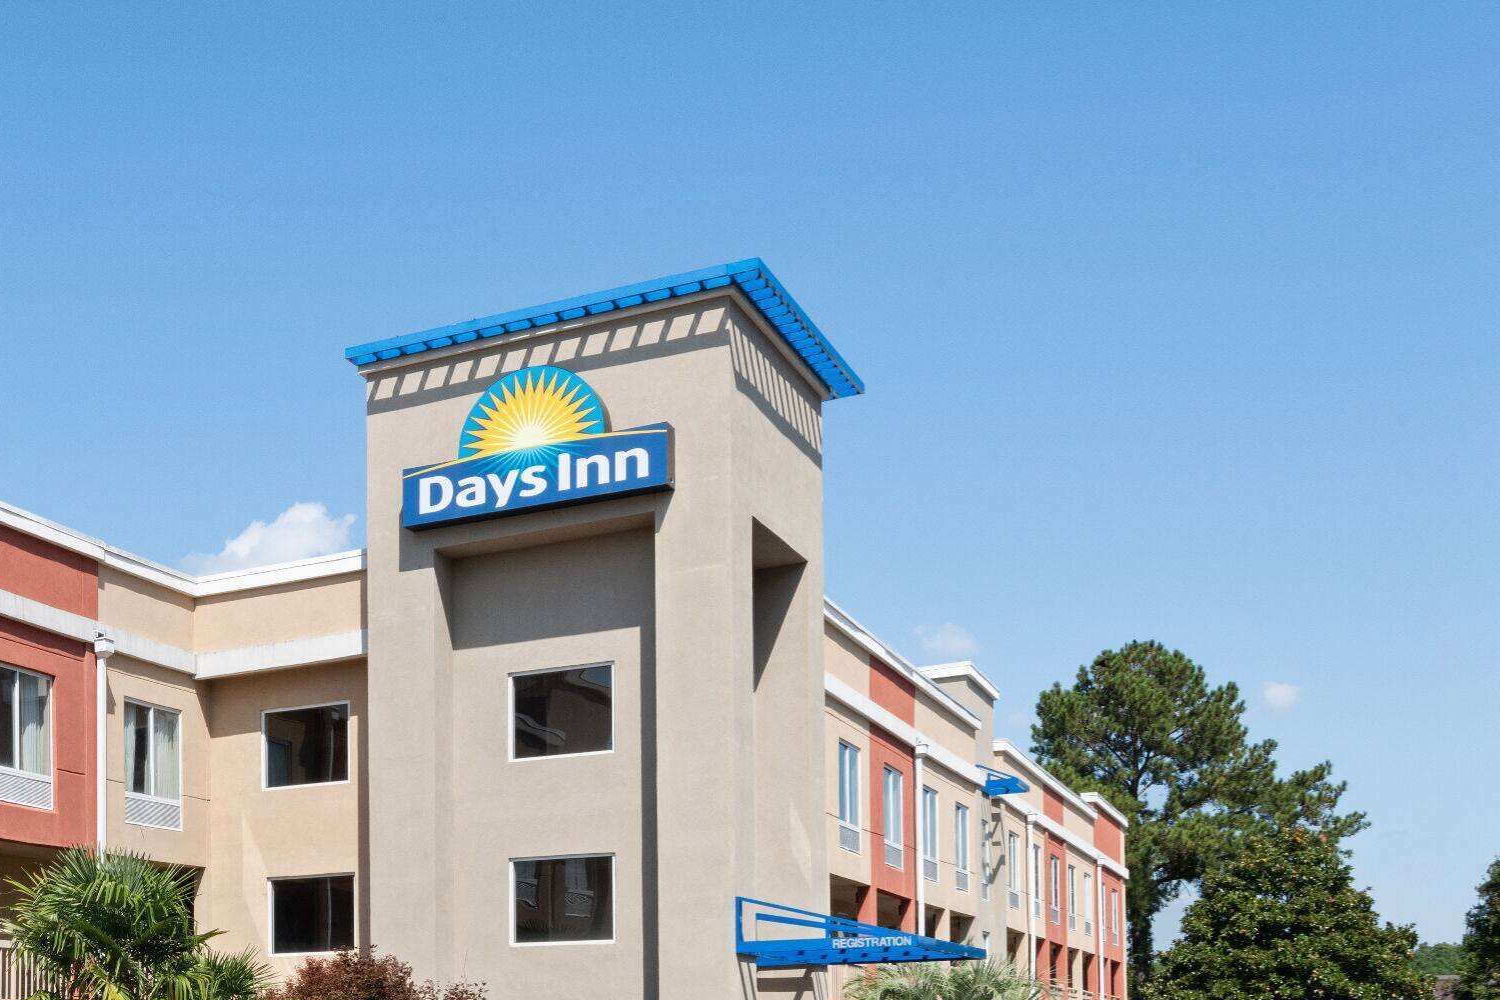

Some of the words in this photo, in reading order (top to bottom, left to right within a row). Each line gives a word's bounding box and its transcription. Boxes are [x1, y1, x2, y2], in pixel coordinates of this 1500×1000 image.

[418, 465, 547, 515] Days
[558, 447, 649, 491] Inn
[832, 935, 912, 949] REGISTRATION
